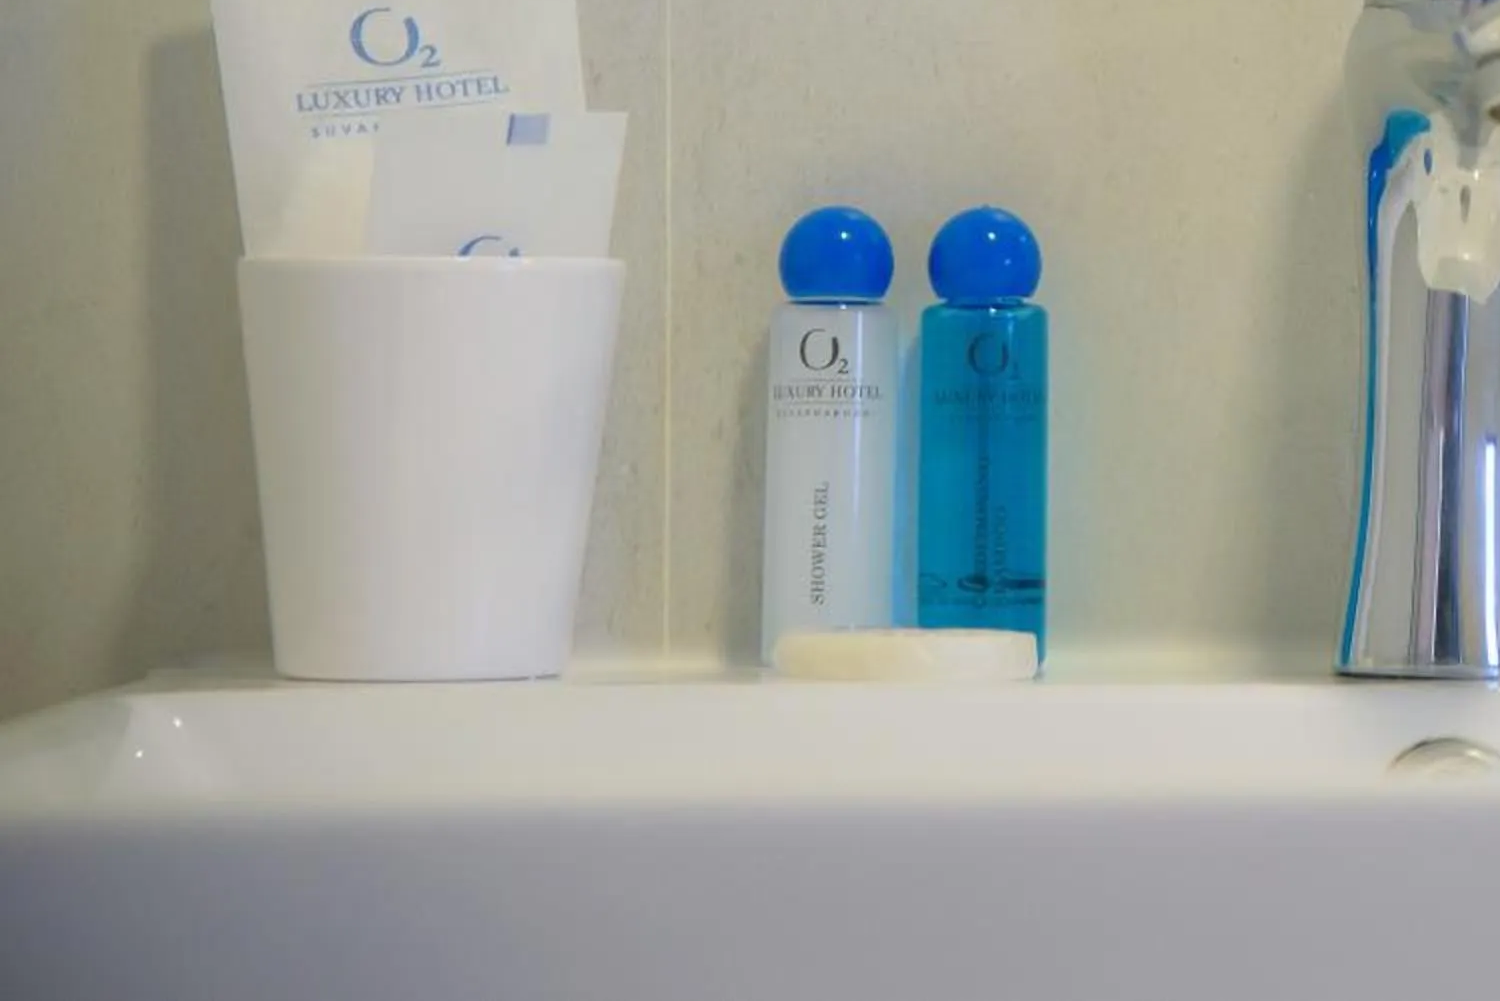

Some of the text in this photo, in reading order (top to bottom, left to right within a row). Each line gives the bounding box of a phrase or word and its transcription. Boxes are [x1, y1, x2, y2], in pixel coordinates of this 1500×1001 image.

[296, 75, 510, 113] LUXURY HOTEL
[830, 384, 883, 401] HOTEL
[809, 481, 829, 605] SHOWER GEL
